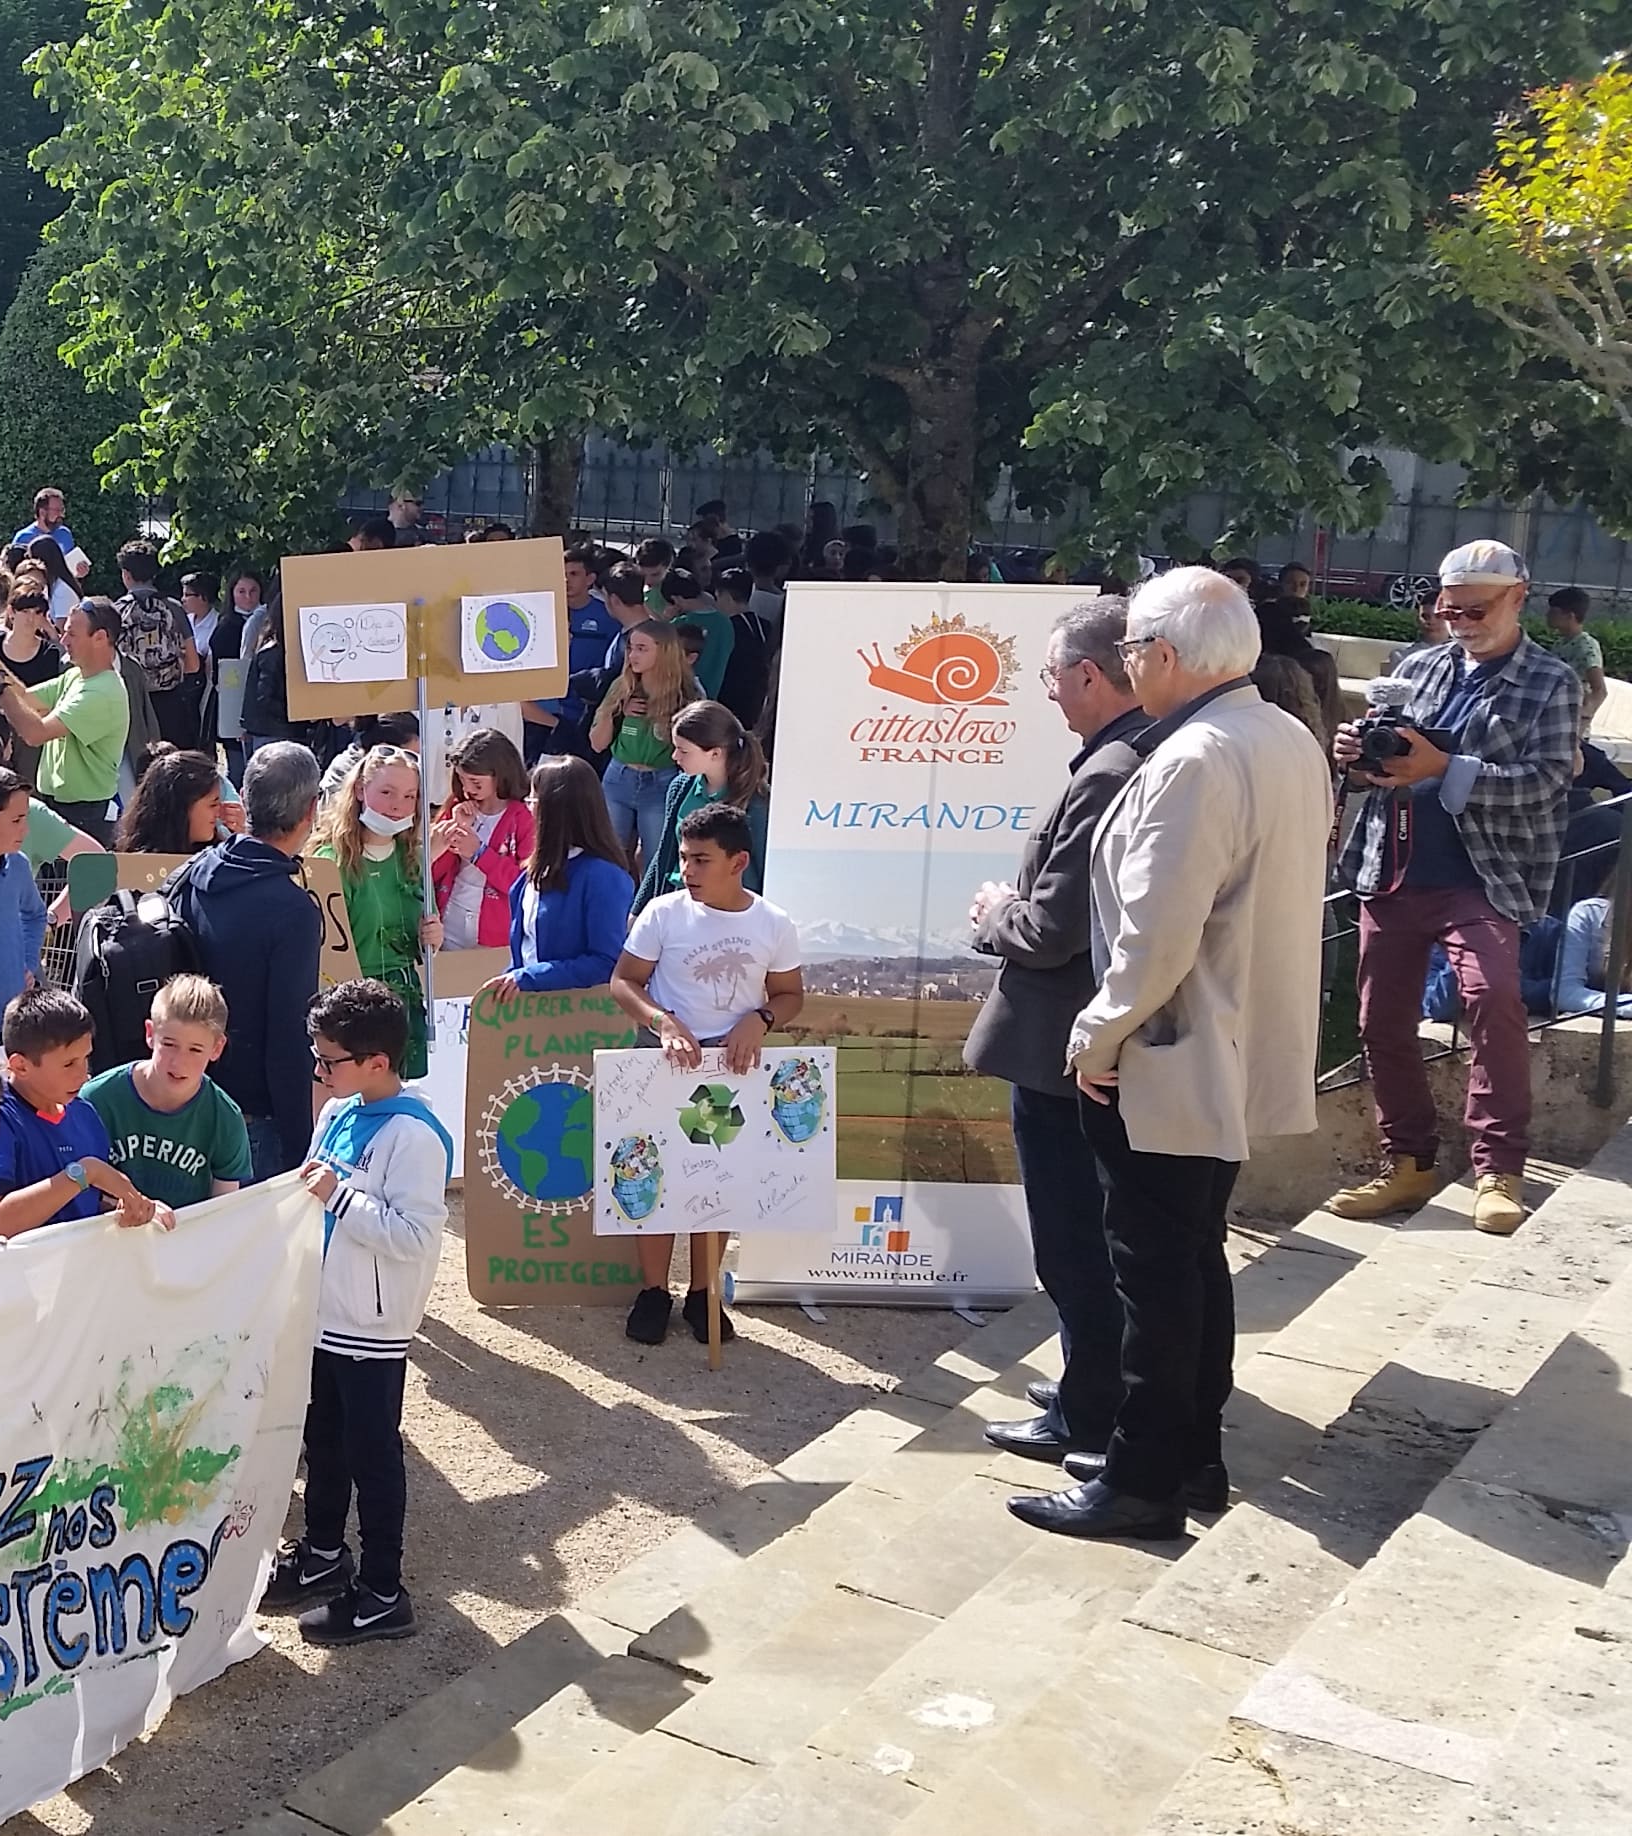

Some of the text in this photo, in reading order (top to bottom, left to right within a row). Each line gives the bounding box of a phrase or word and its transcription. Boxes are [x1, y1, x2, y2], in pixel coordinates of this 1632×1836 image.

[849, 706, 1016, 745] cittaslow
[859, 747, 1004, 764] FRANCE
[804, 799, 1037, 832] MIRANDE
[1398, 809, 1409, 840] Canon
[682, 944, 709, 966] PALM
[474, 988, 574, 1031] QUERER
[580, 995, 625, 1017] NUE
[108, 1134, 207, 1177] SUPERIOR
[523, 1212, 571, 1249] ES
[808, 1268, 969, 1283] www.mirande.fr
[831, 1252, 933, 1267] MIRANDE
